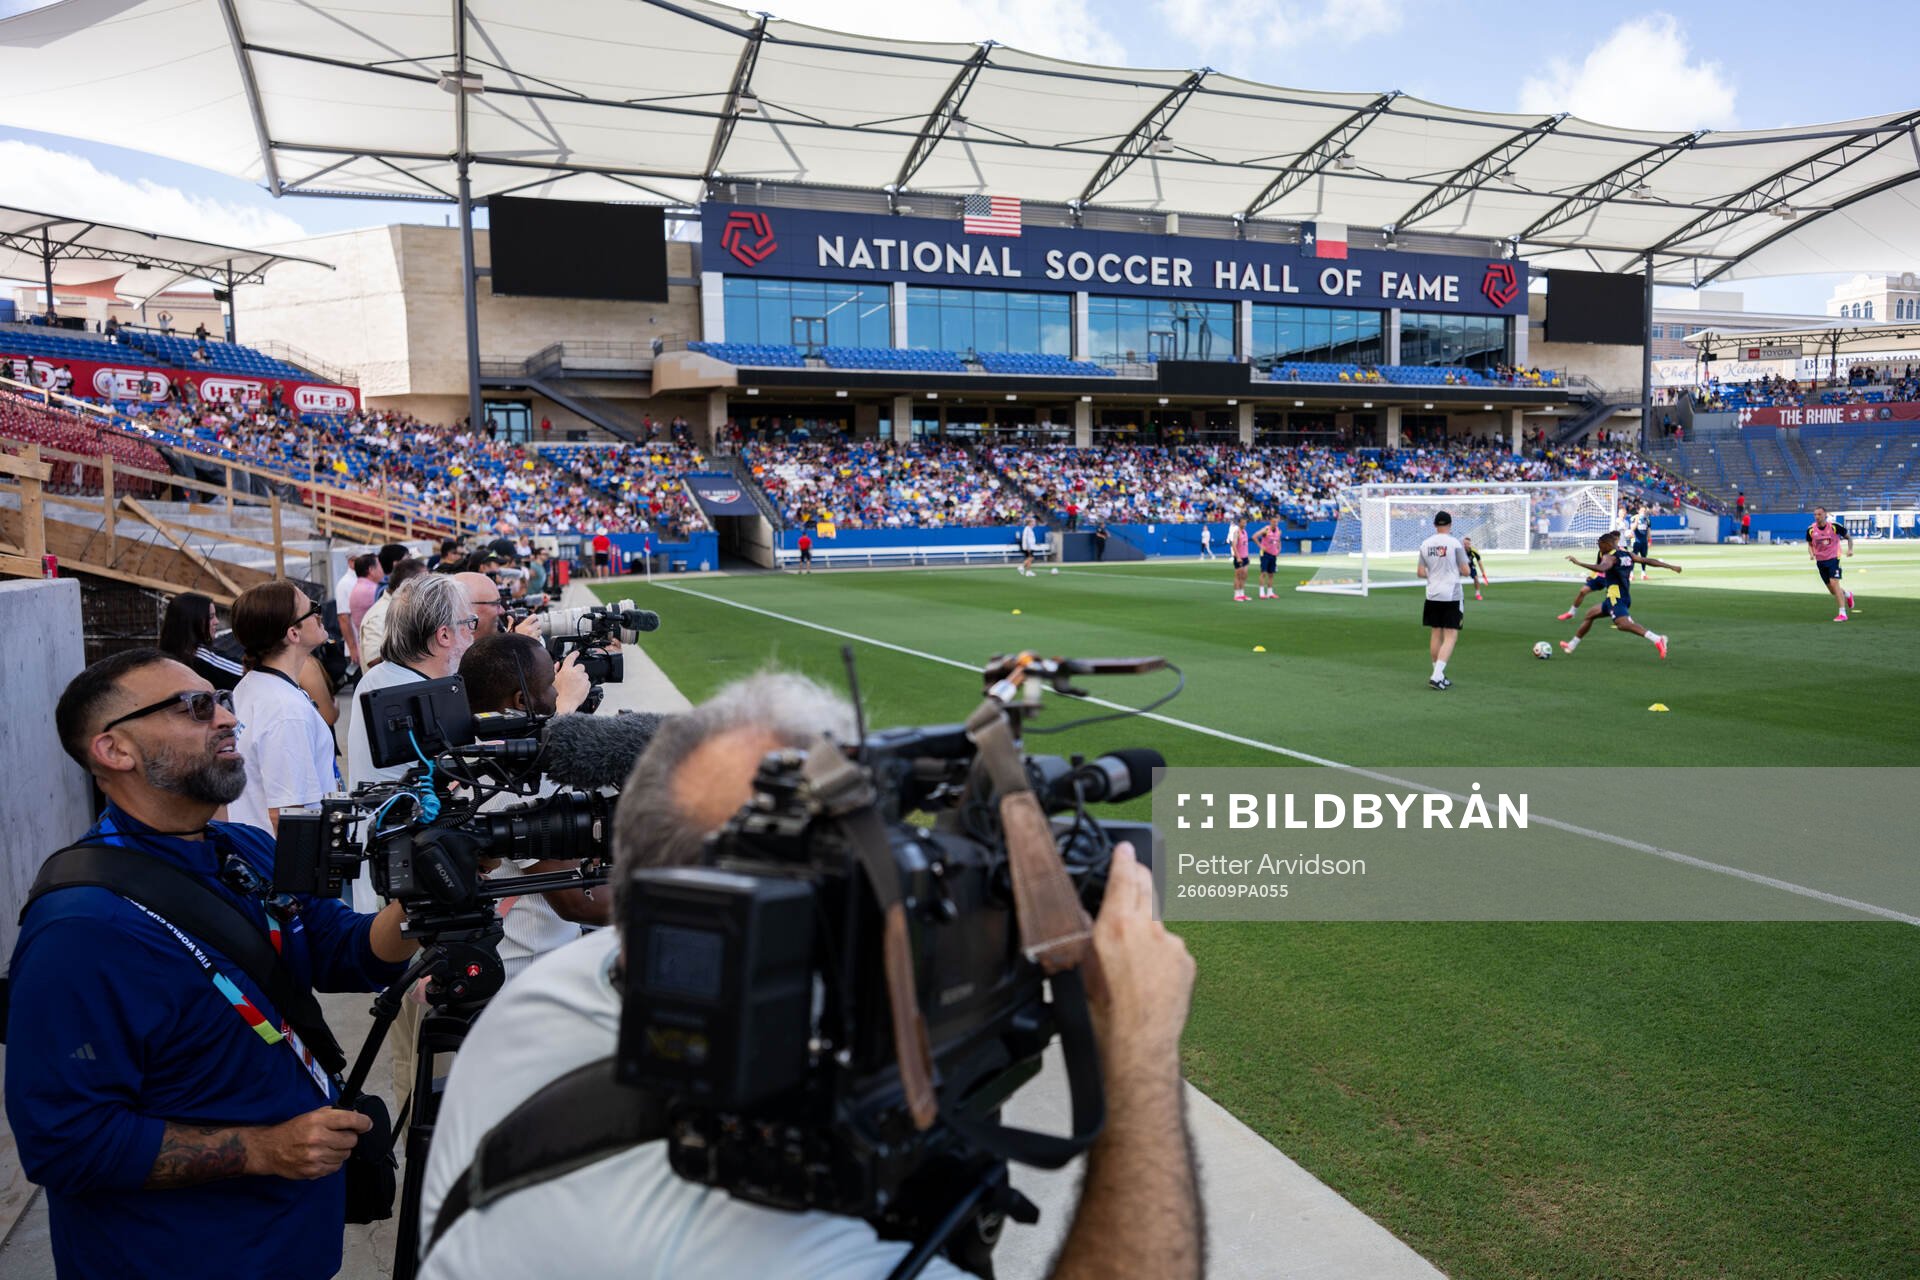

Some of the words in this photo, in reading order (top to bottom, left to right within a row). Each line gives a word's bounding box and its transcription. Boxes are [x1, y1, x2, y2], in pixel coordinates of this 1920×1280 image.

[817, 234, 1022, 278] NATIONAL
[1045, 248, 1193, 288] SOCCER
[1215, 260, 1299, 293] HALL
[1319, 267, 1362, 296] OF
[1381, 271, 1460, 302] FAME
[1762, 348, 1794, 358] TOYOTA
[1779, 409, 1803, 425] THE
[1806, 407, 1845, 424] RHINE
[434, 863, 456, 888] SONY
[146, 910, 167, 924] CUP
[166, 922, 197, 952] WORLD
[194, 949, 212, 969] FIFA
